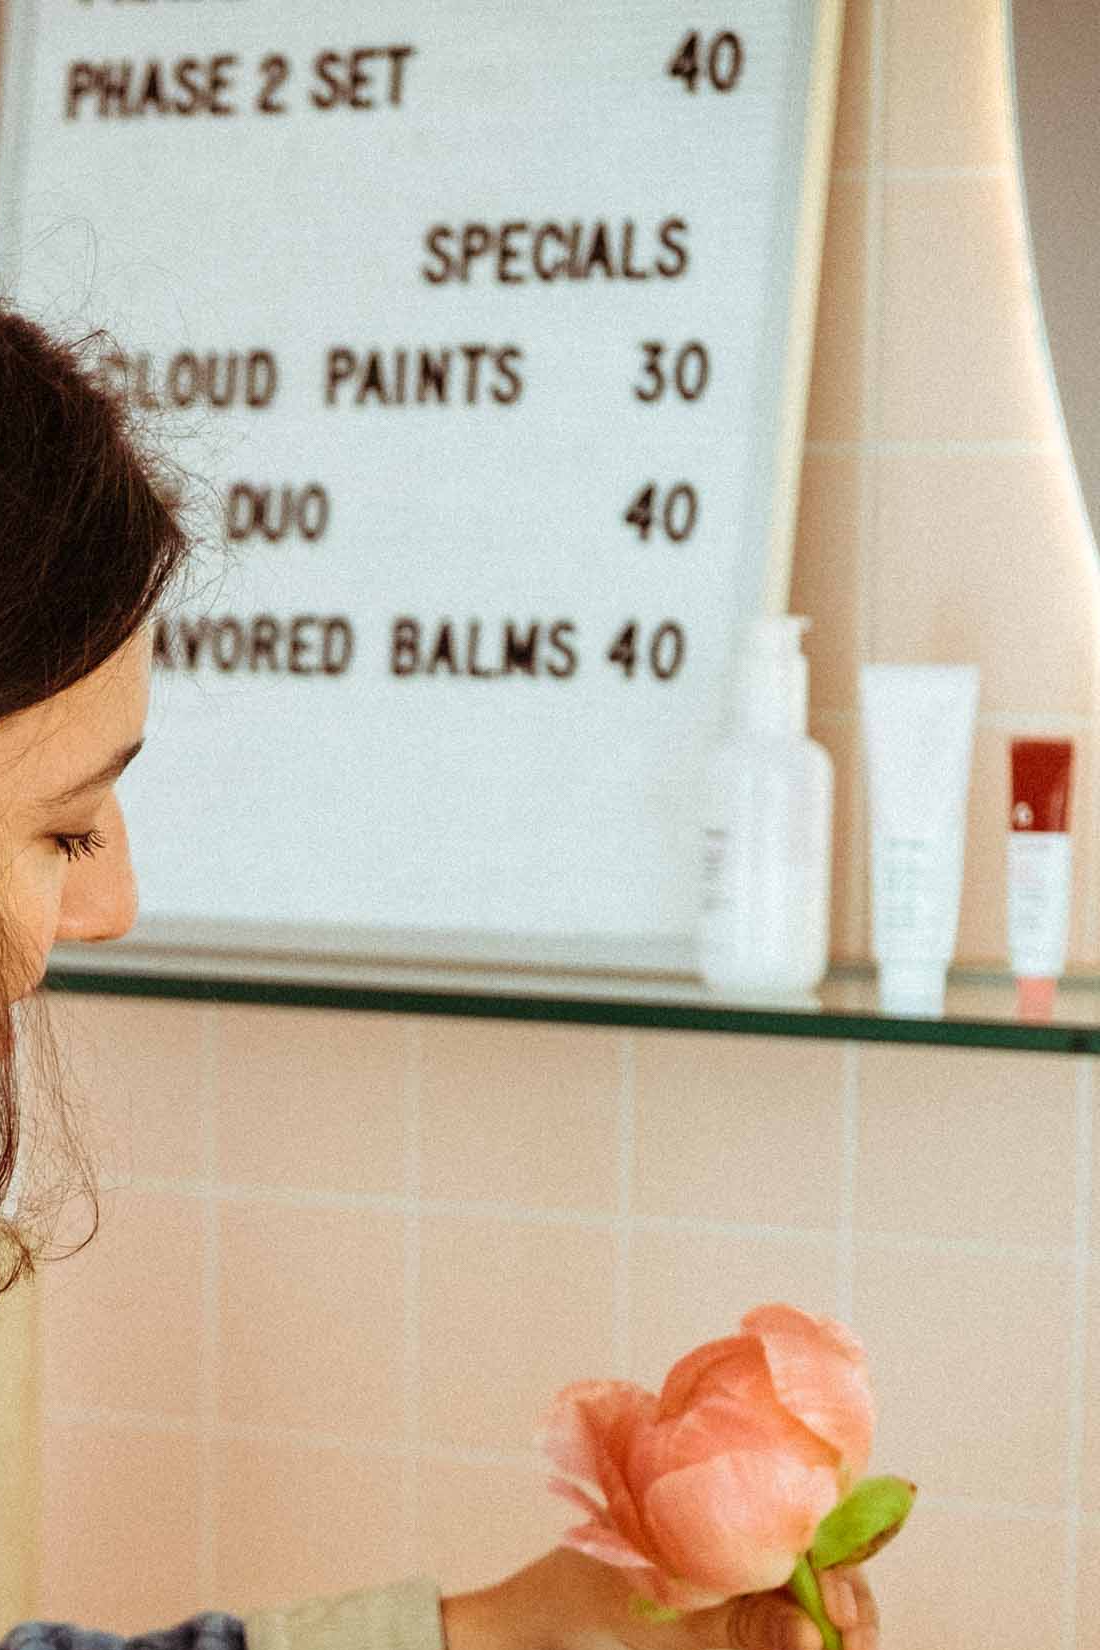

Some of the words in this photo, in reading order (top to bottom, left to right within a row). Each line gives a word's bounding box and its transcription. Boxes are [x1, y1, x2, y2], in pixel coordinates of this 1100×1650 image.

[64, 53, 240, 121] PHASE
[254, 52, 293, 116] 2
[307, 43, 419, 113] SET
[665, 28, 747, 95] 40
[421, 214, 691, 287] SPECIALS
[323, 342, 524, 408] PAINTS
[633, 338, 712, 405] 30
[225, 481, 331, 545] DUO
[621, 480, 700, 546] 40
[150, 613, 356, 678] AVORED
[389, 615, 580, 681] BALMS
[606, 619, 687, 684] 40
